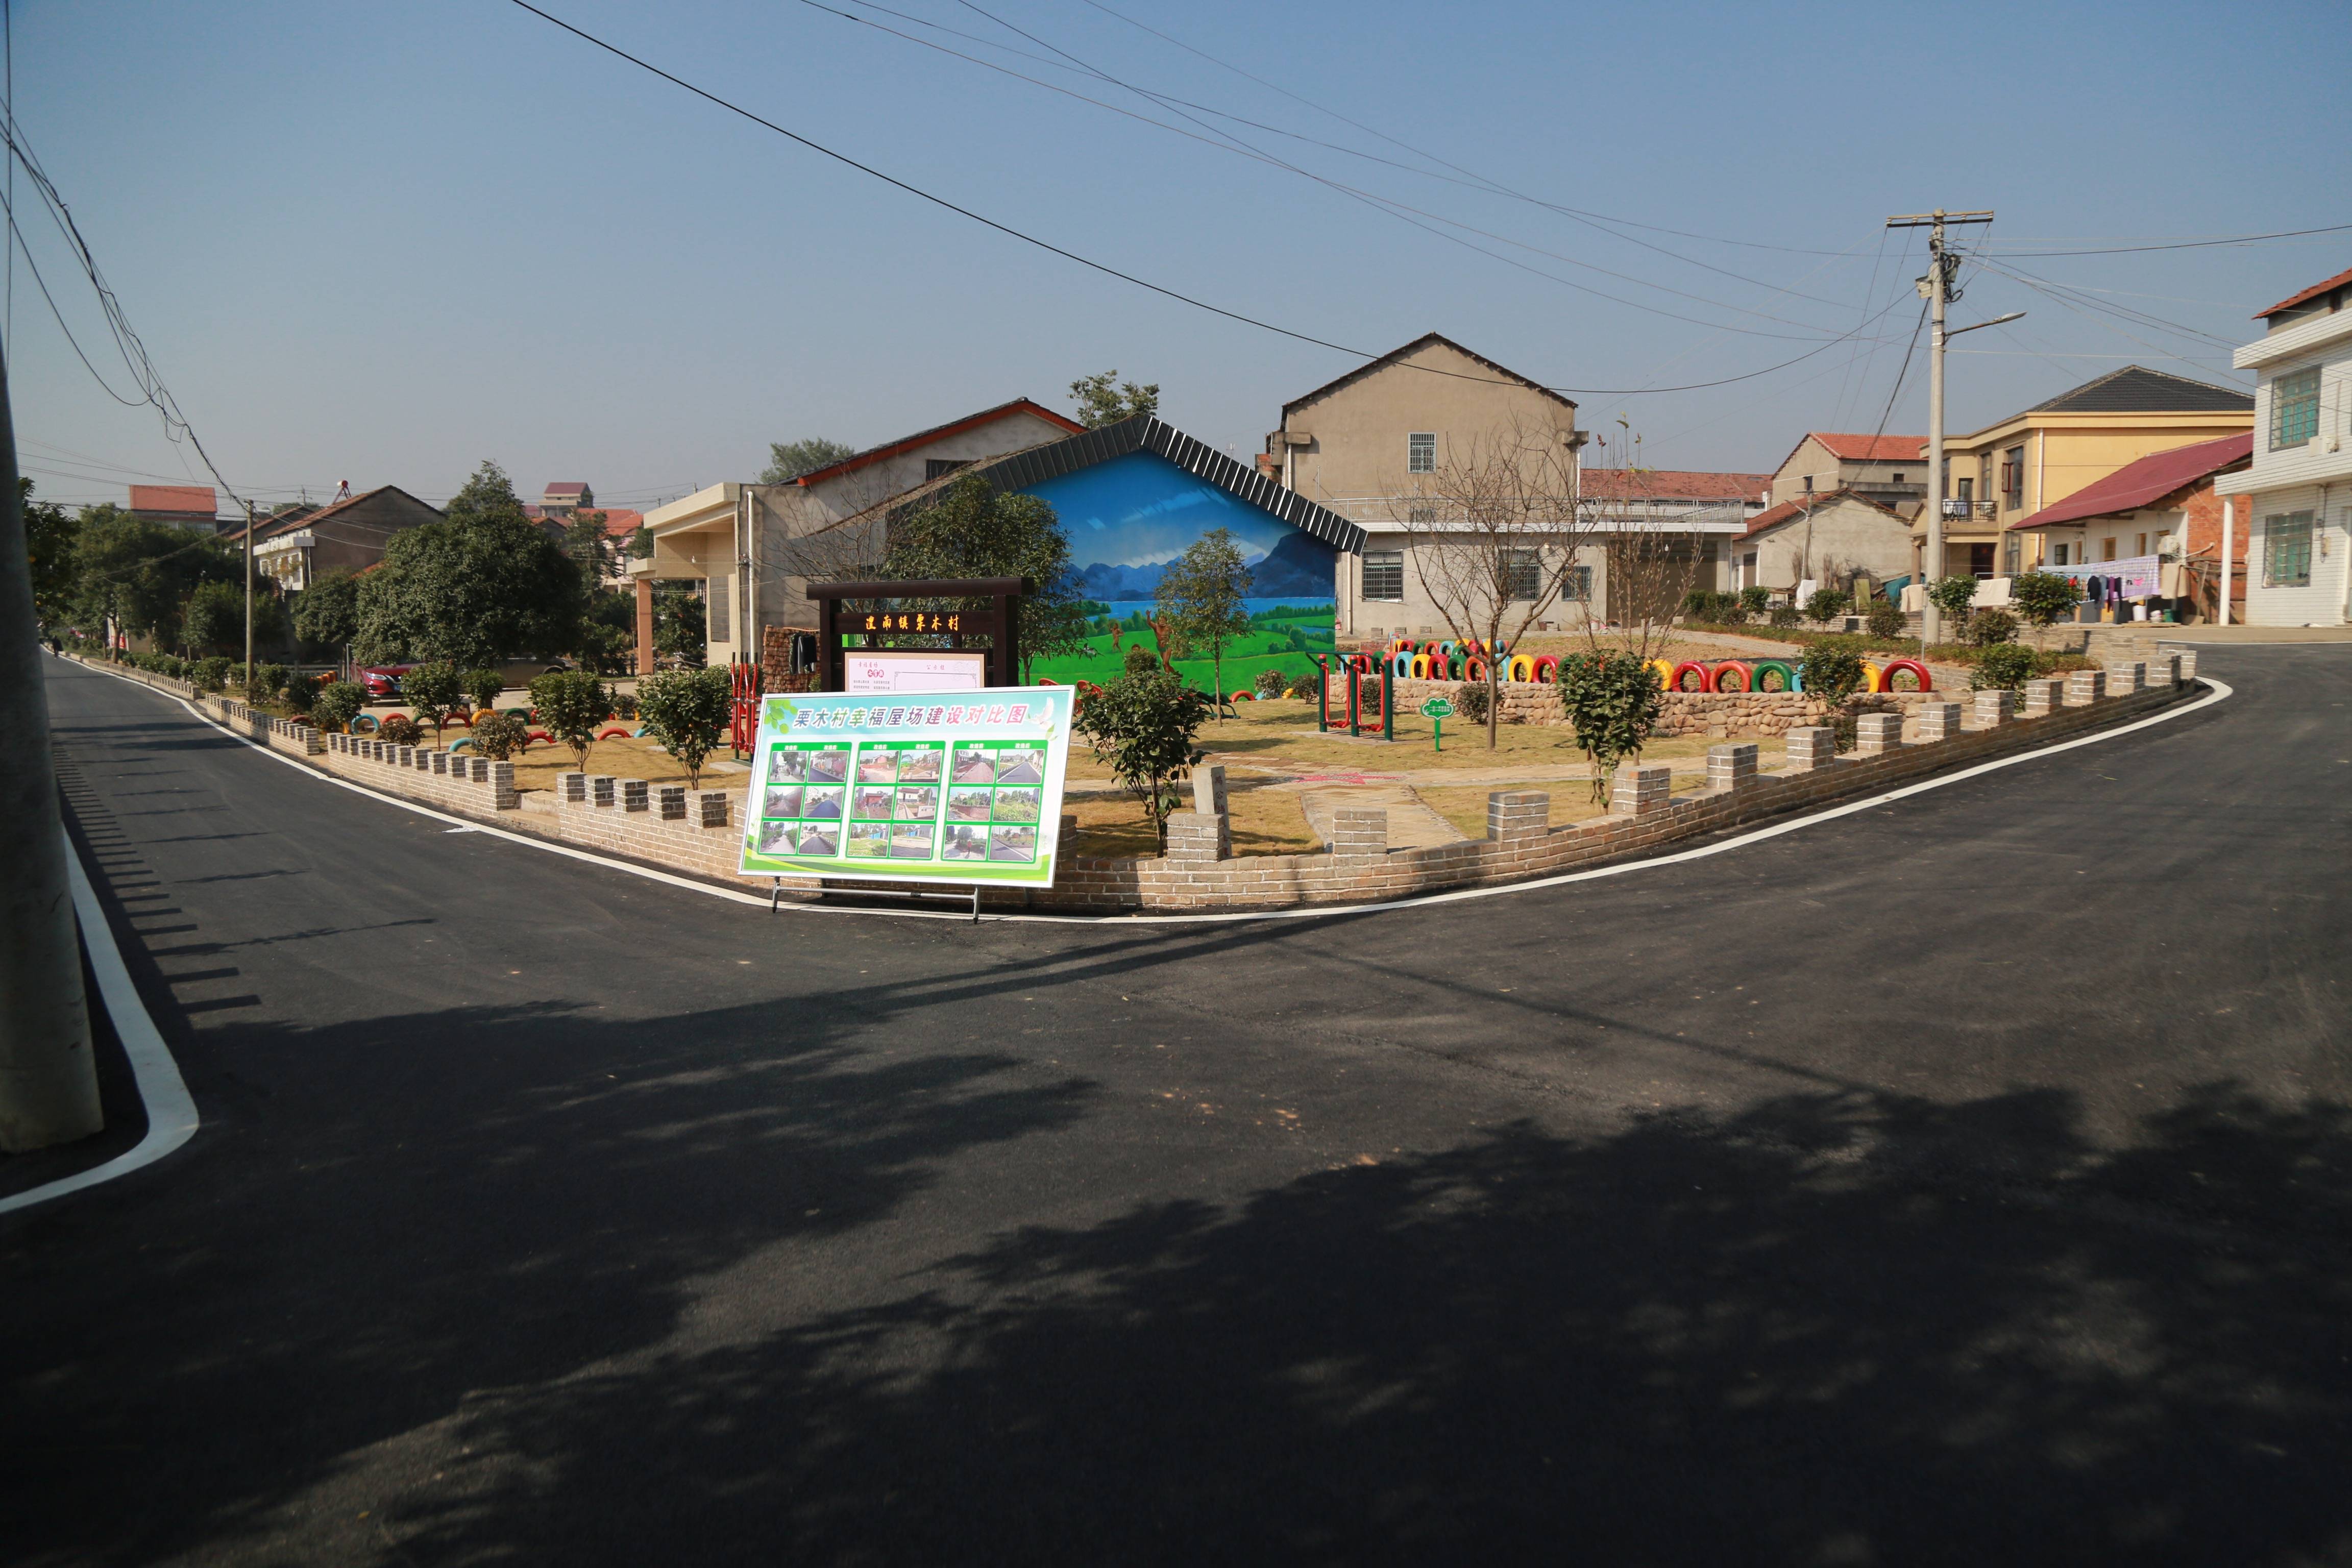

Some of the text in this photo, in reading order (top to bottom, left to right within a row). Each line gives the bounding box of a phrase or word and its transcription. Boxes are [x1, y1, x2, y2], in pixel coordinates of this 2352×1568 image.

[794, 705, 1027, 727] 栗木村幸福屋场建设对比图
